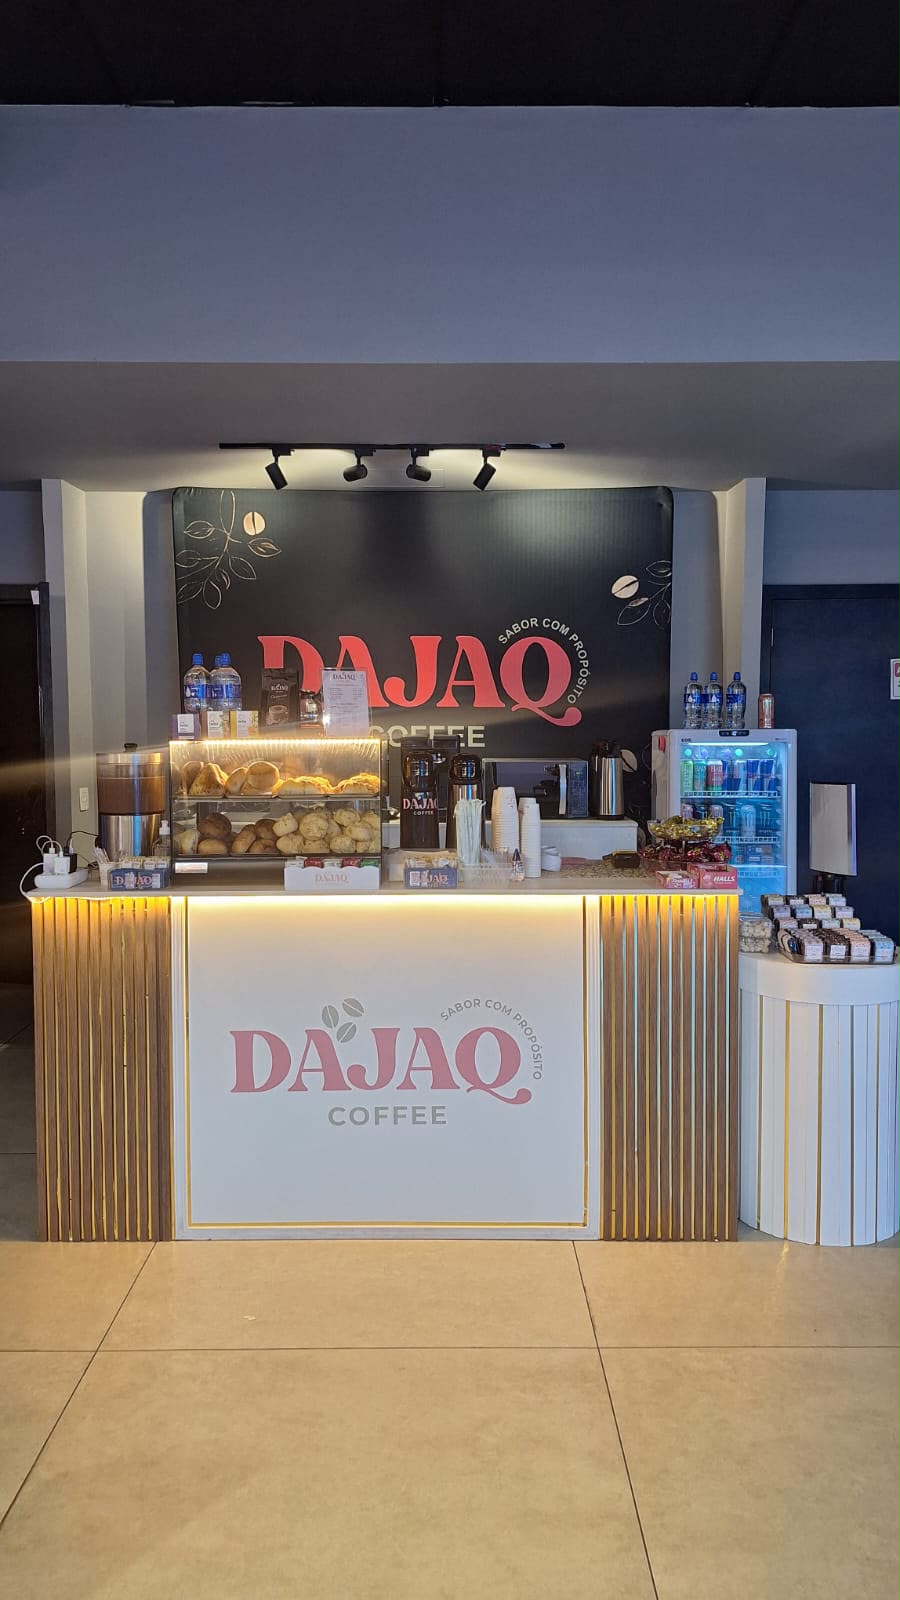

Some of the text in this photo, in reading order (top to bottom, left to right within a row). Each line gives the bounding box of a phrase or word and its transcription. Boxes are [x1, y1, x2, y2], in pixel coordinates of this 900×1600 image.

[257, 635, 582, 727] DAJAQ
[498, 617, 591, 704] SABOR COM PROPÓSITO
[115, 875, 153, 886] DAQ
[230, 1026, 533, 1105] DAJAQ
[440, 998, 543, 1080] SABOR COM PROPÓSITO
[328, 1105, 447, 1126] COFFEE
